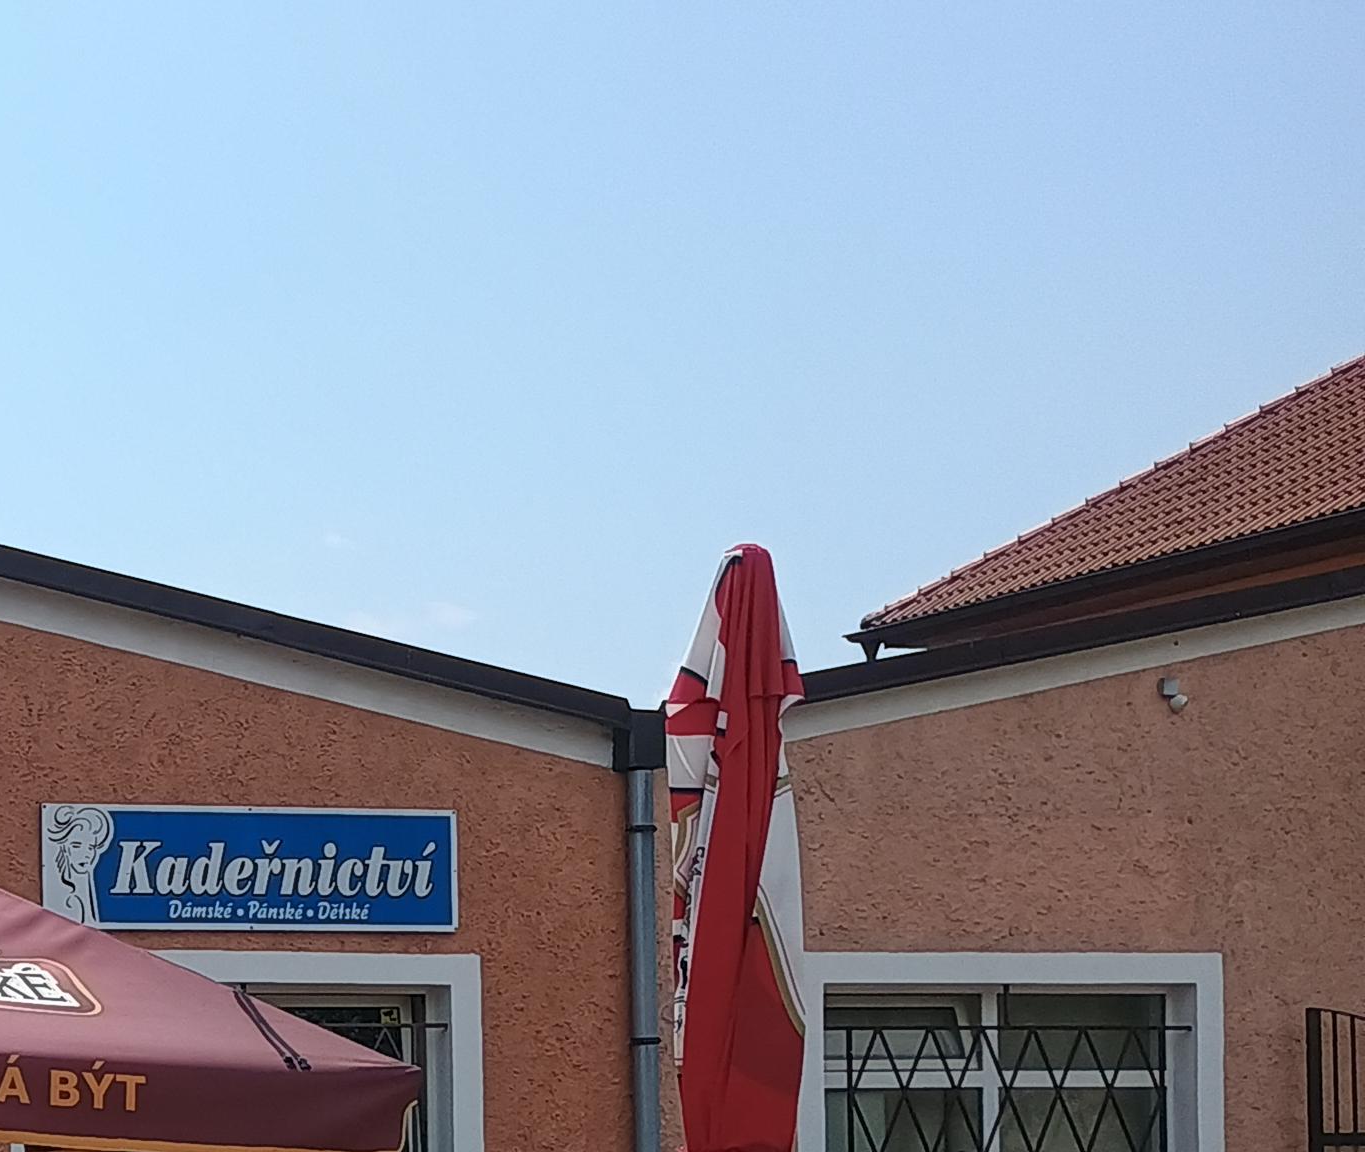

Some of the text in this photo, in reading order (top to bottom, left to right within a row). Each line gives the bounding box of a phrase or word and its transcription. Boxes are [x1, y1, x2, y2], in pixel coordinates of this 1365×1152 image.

[110, 839, 437, 898] Kadeřnictví
[169, 900, 370, 920] Dámské Pánské Dětské
[50, 1060, 147, 1112] BÝT
